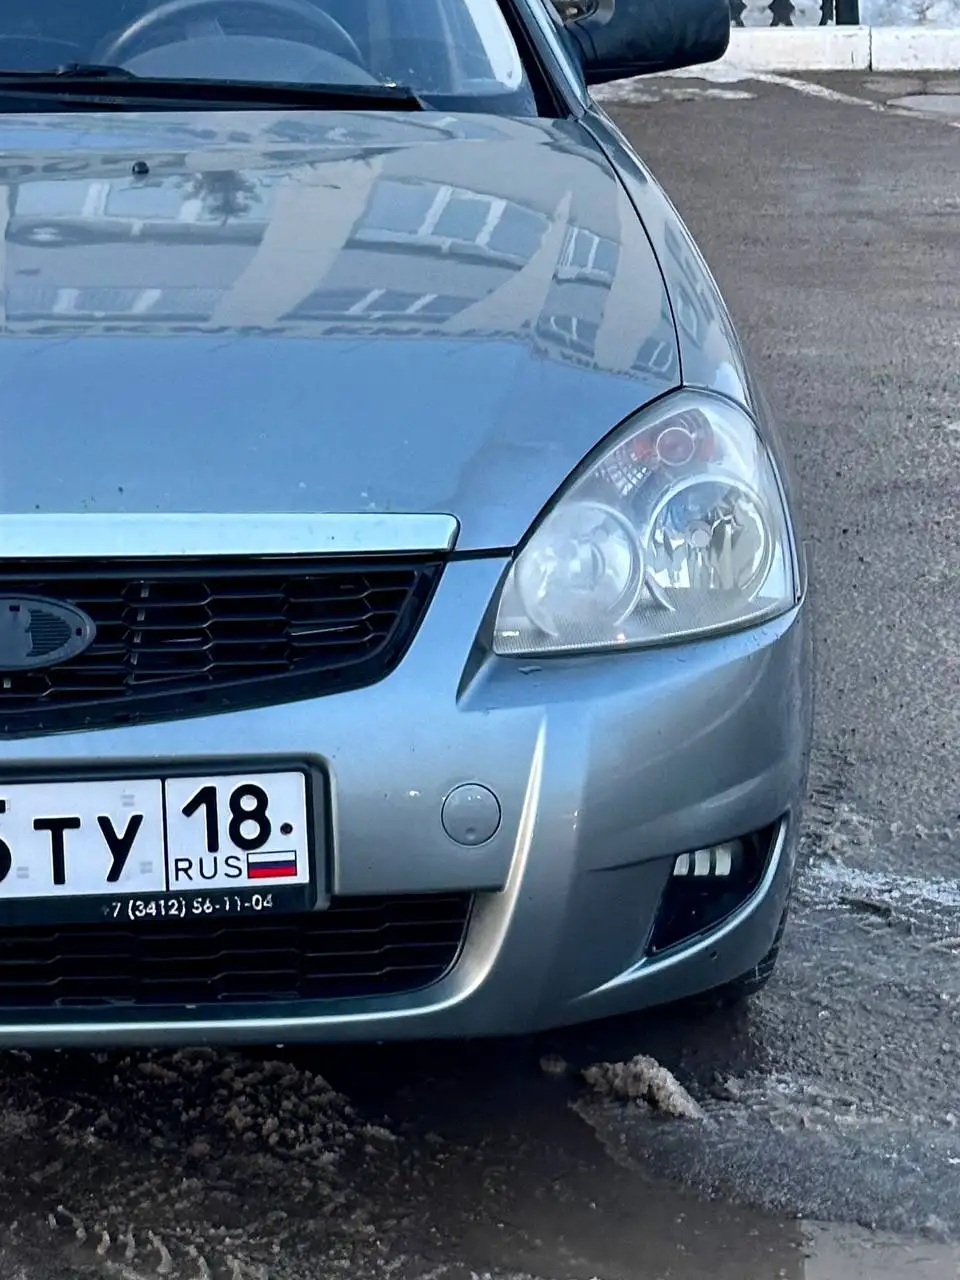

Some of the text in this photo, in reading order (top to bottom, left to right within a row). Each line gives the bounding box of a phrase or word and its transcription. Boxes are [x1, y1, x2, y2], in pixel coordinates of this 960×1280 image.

[181, 783, 272, 853] 18
[174, 855, 243, 881] RUS
[127, 897, 187, 921] (3412)
